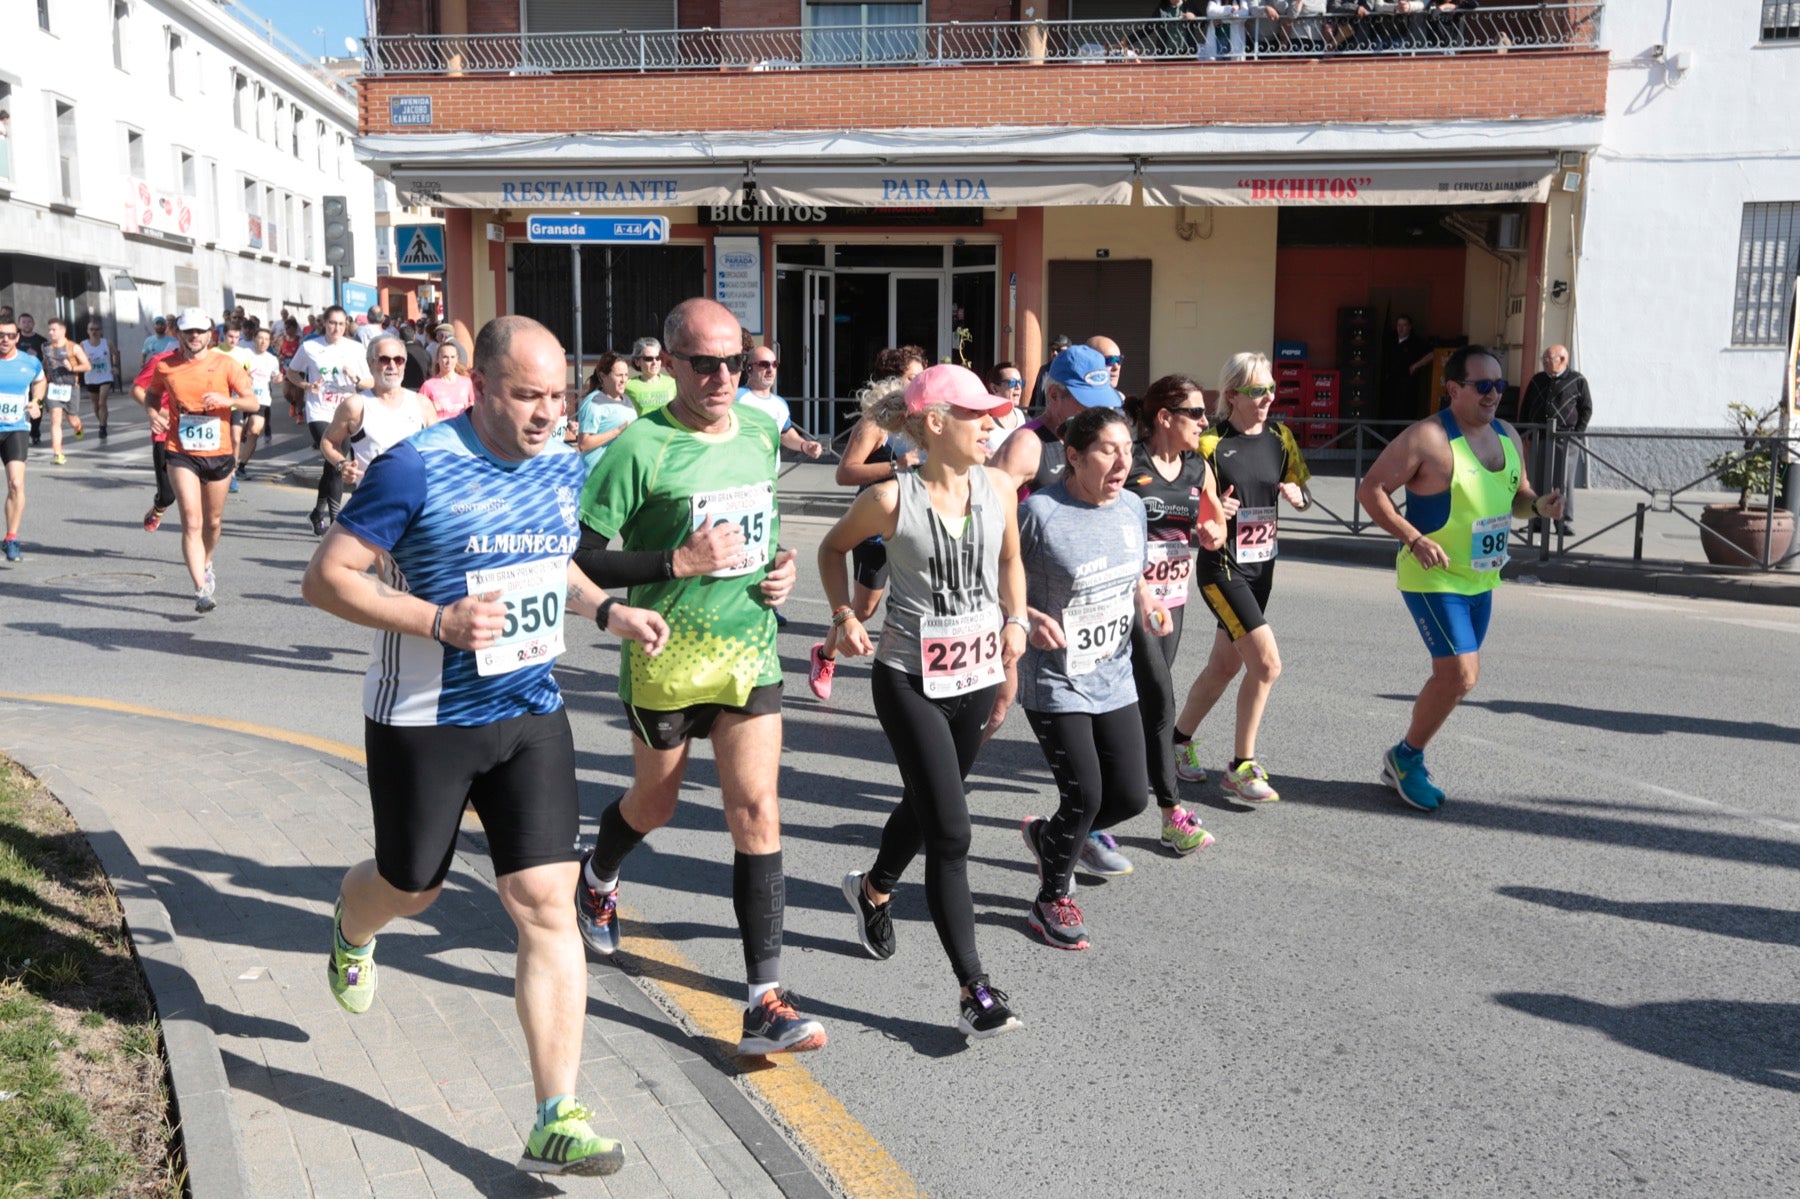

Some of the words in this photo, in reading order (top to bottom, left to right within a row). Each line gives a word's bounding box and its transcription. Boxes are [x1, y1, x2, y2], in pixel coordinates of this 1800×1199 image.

[393, 114, 430, 123] CAMARERO
[402, 105, 428, 114] JACOBO
[502, 180, 678, 203] RESTAURANTE
[882, 179, 991, 200] PARADA
[1454, 182, 1492, 192] CERVEZAS
[710, 205, 827, 221] BICHITOS
[531, 223, 586, 236] Granada
[0, 403, 18, 414] 84
[186, 425, 214, 440] 618
[926, 504, 984, 592] JUST
[1482, 531, 1505, 555] 98
[1143, 559, 1190, 581] 2053
[502, 592, 559, 638] 650
[1077, 615, 1129, 650] 3078
[927, 631, 998, 672] 2213
